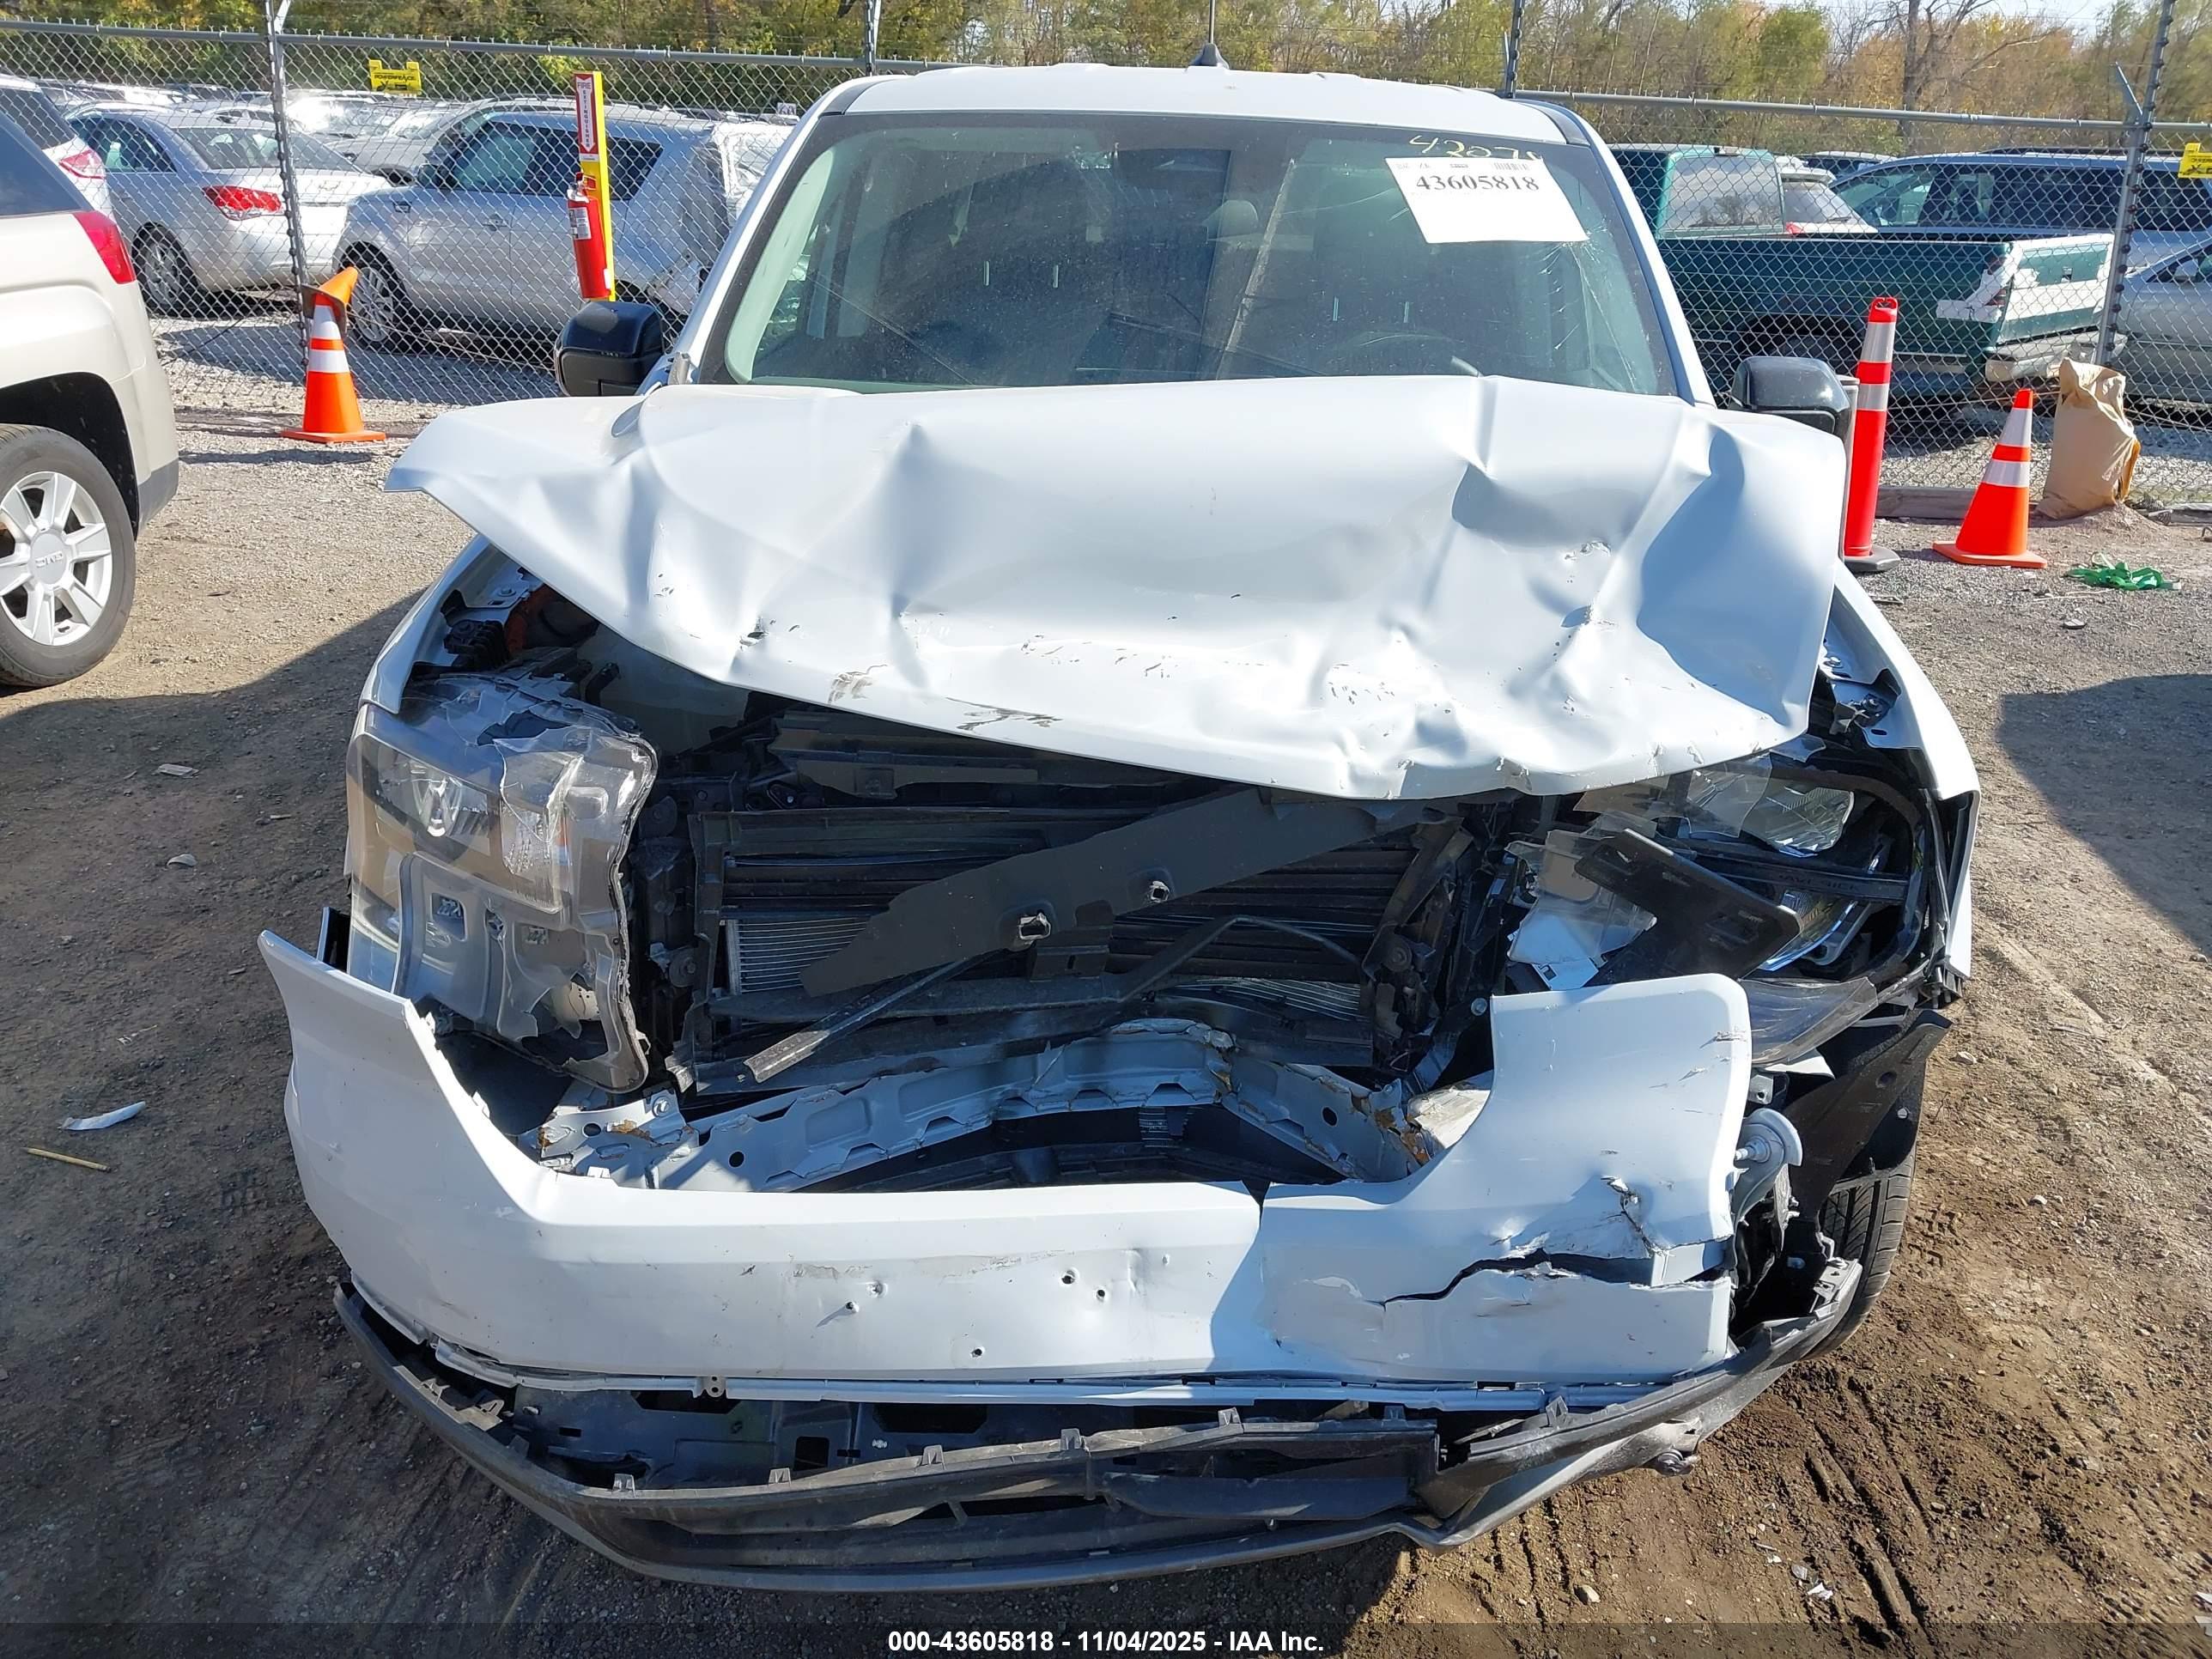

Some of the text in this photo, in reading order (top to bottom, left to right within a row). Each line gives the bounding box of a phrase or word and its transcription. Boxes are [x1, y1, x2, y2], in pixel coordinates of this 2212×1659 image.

[582, 89, 591, 148] EXTINGUISHER
[1417, 174, 1540, 191] 43605818
[35, 552, 63, 568] GMC
